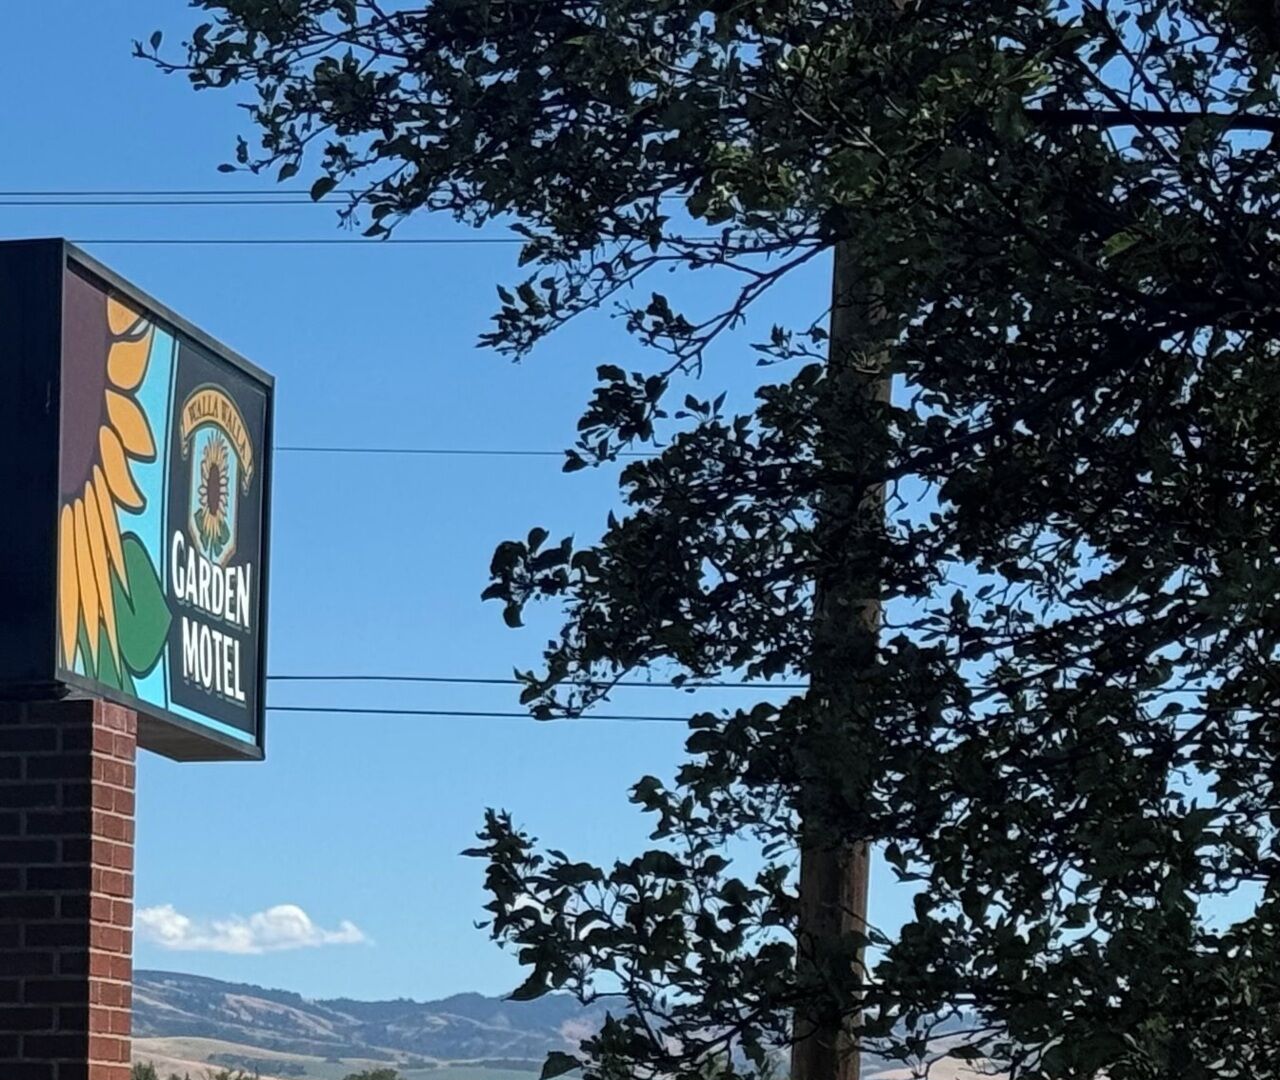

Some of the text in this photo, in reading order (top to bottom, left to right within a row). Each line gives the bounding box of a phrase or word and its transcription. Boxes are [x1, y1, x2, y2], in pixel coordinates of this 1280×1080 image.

[187, 395, 247, 462] WALLA WALLA
[171, 530, 251, 627] GARDEN
[182, 617, 245, 701] MOTEL
